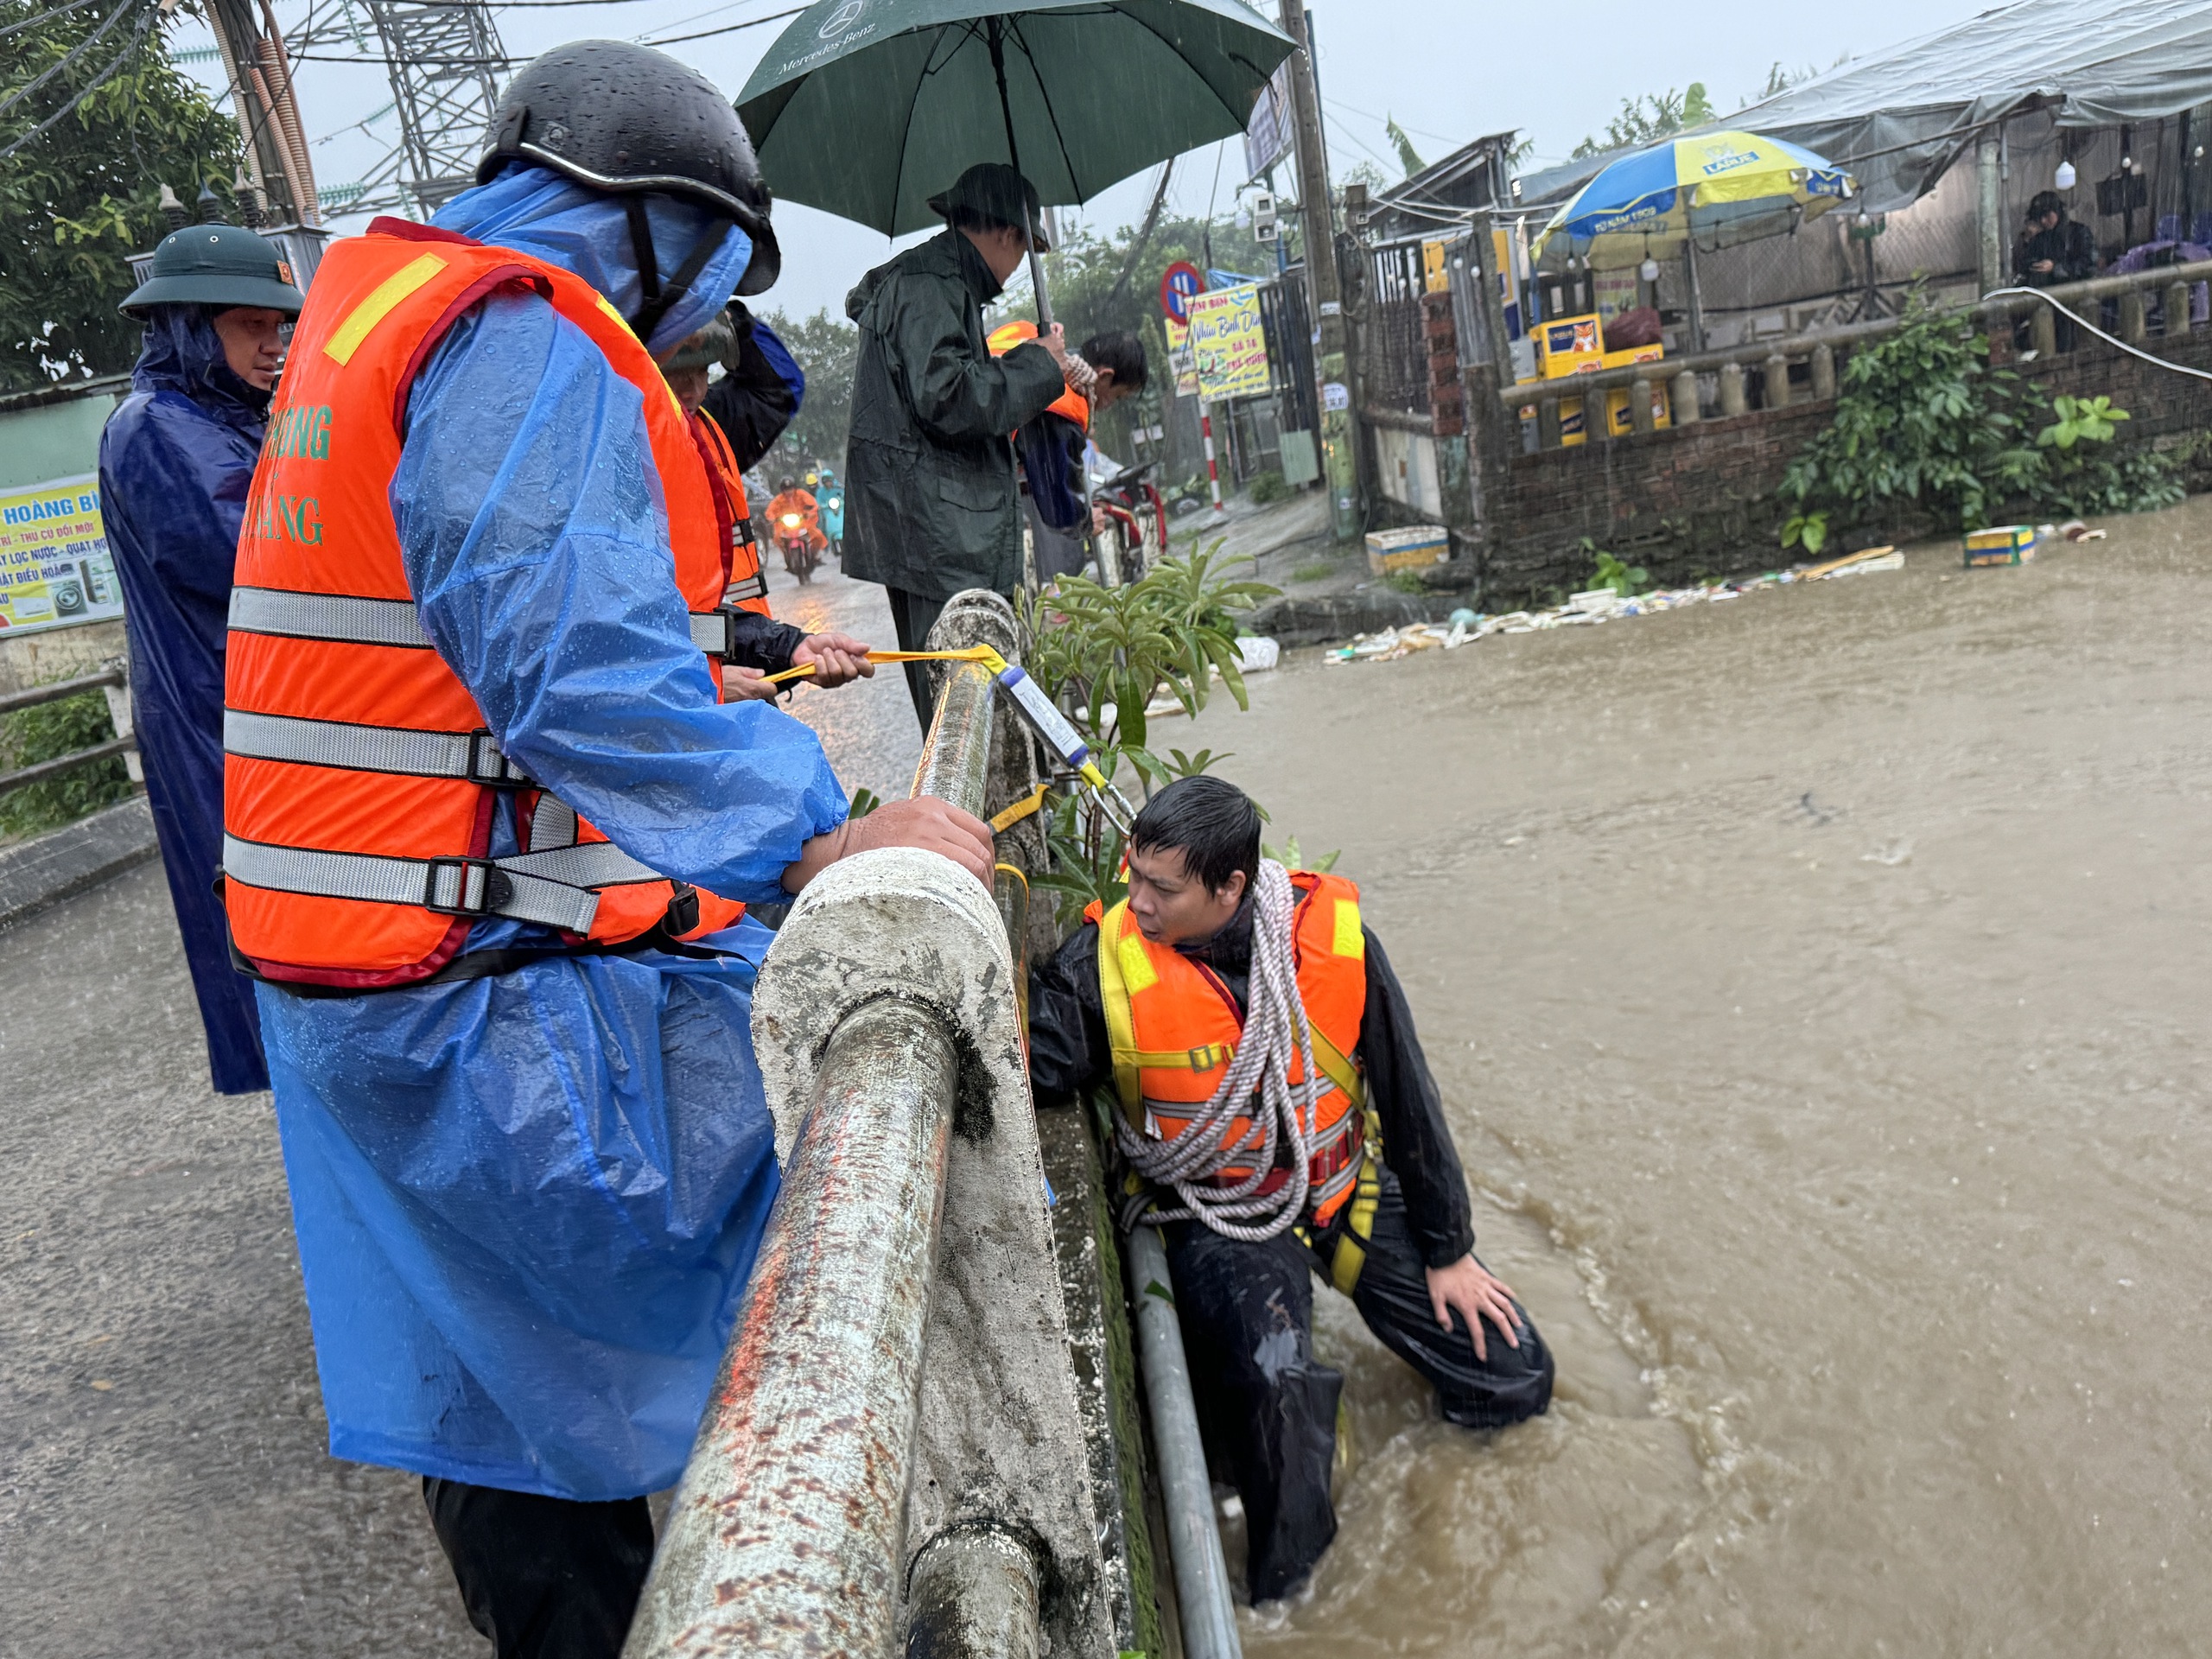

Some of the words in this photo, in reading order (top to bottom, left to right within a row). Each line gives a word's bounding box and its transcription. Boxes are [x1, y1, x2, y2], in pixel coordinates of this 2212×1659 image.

[778, 22, 876, 75] Mercedes-Benz
[3, 499, 75, 525] HOÀNG
[20, 531, 39, 543] THU
[10, 551, 29, 566] LỌC
[30, 545, 58, 561] NƯỚC
